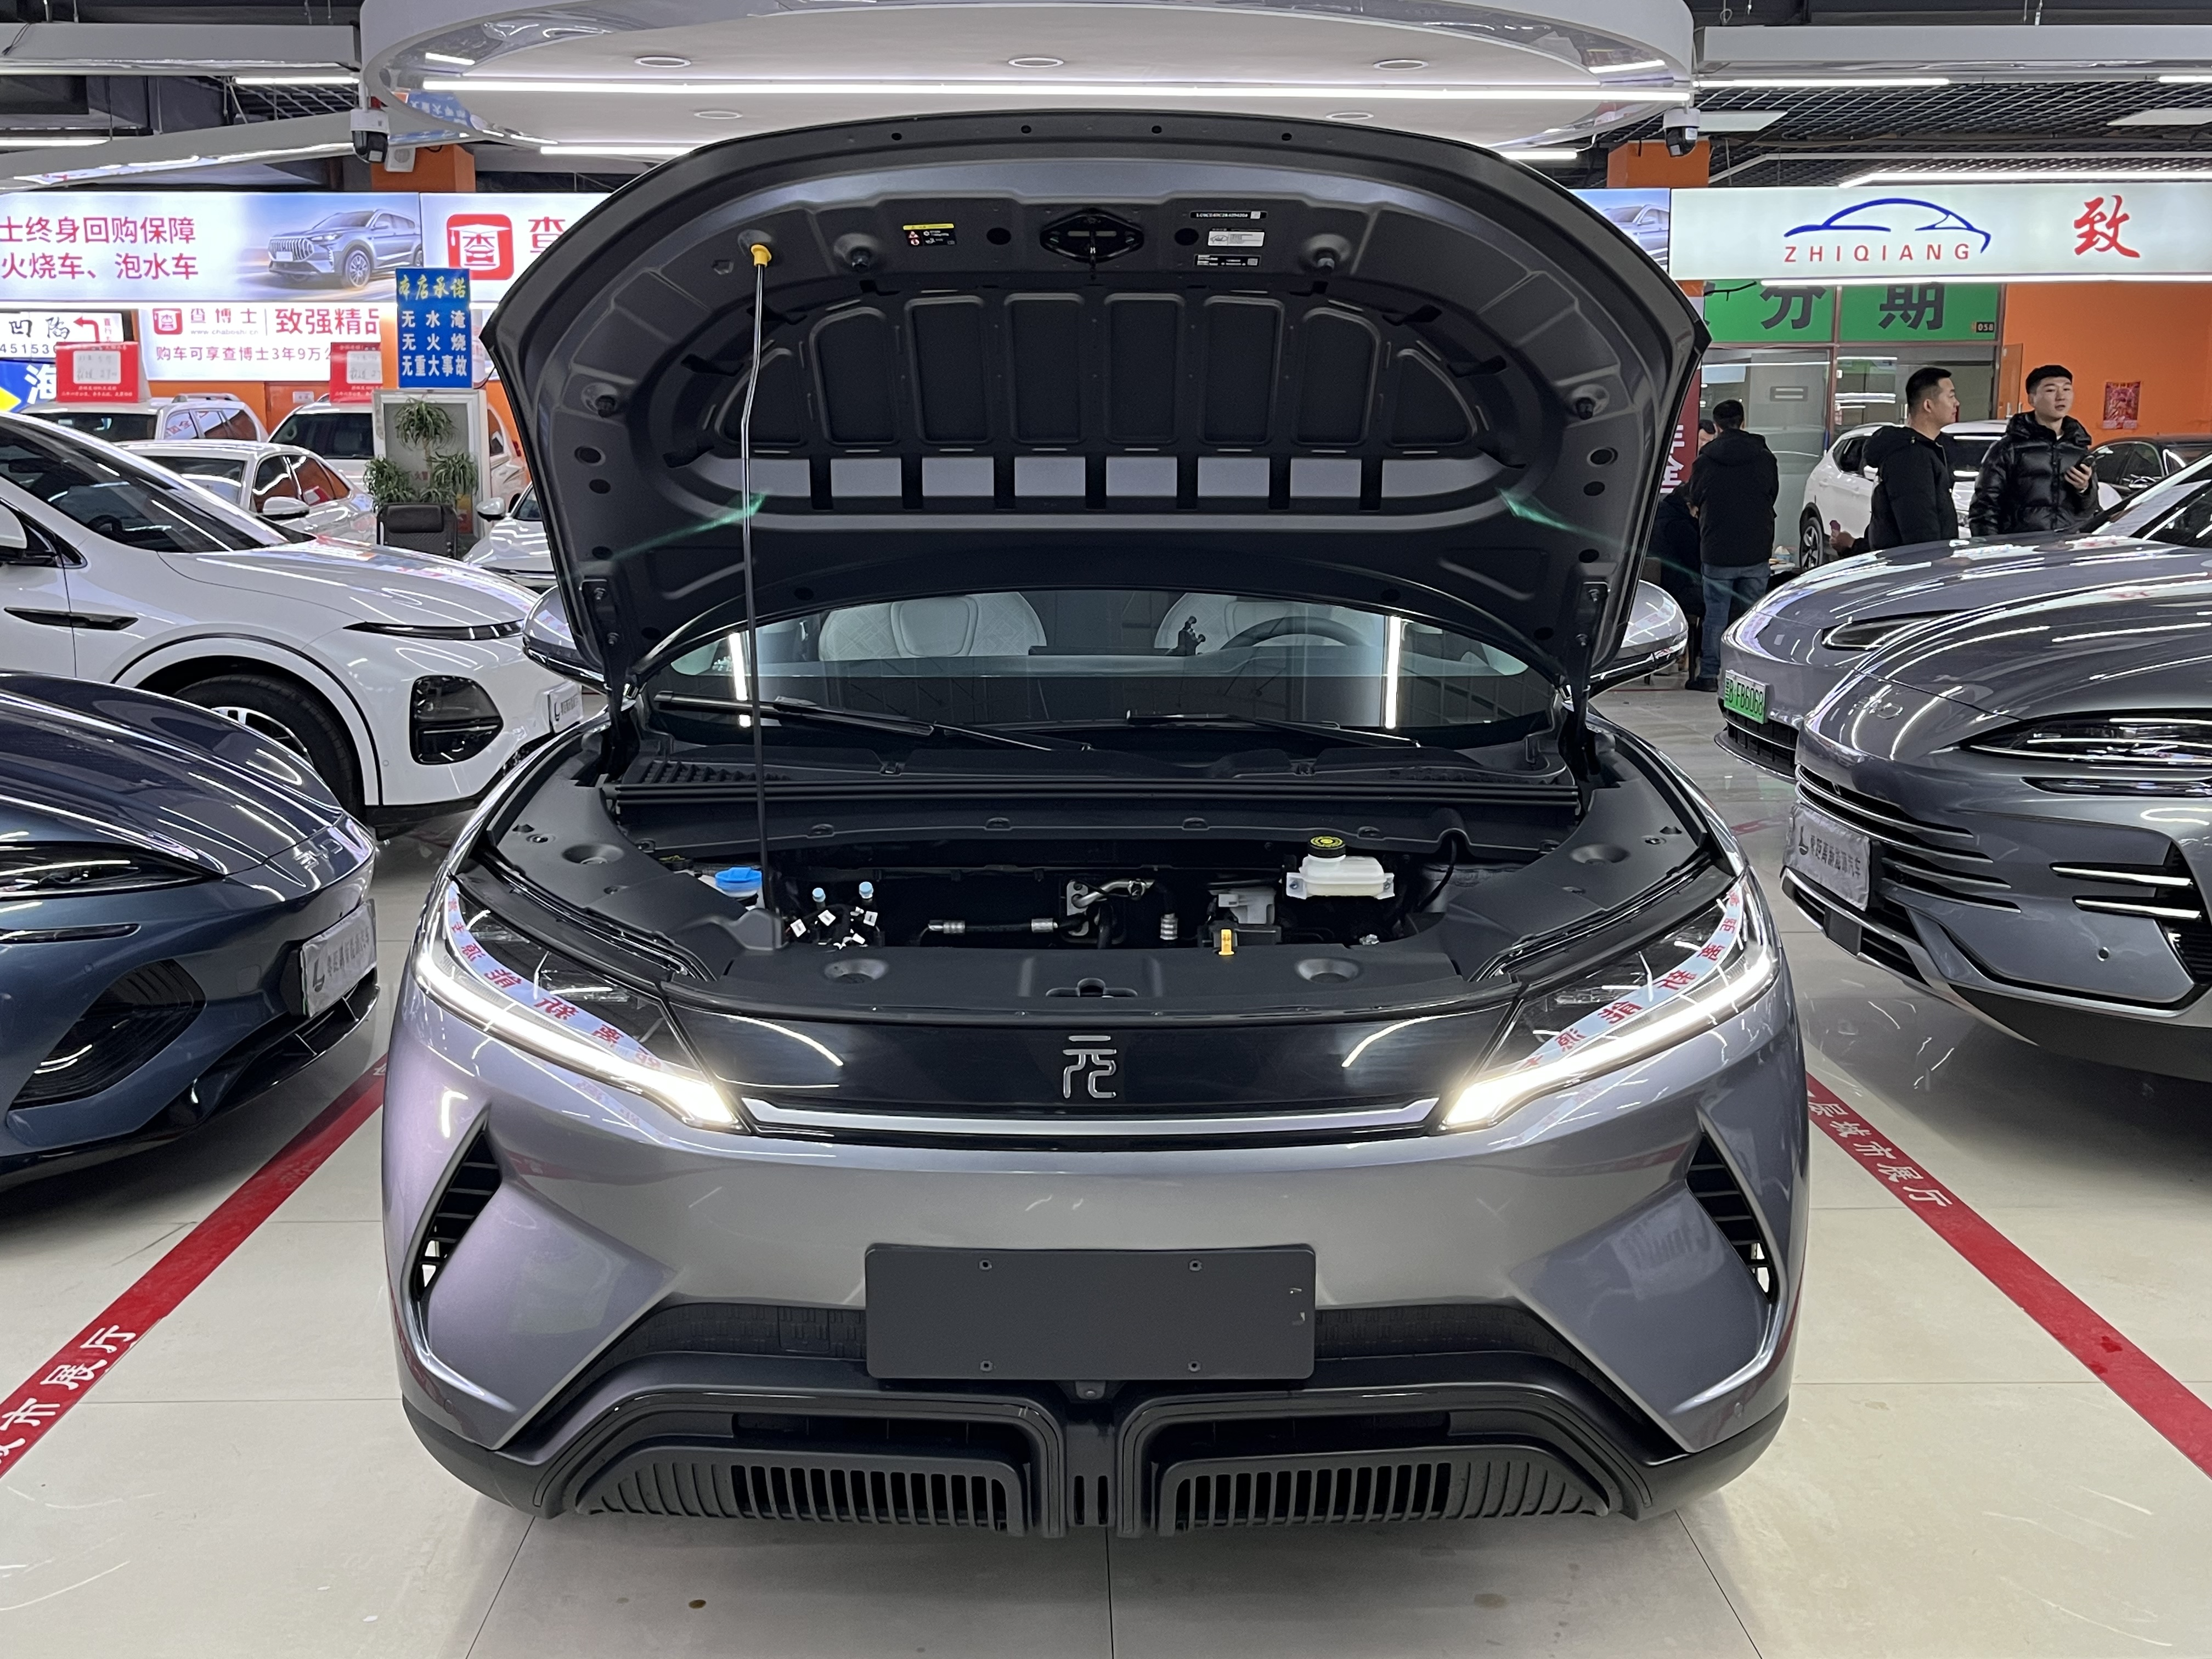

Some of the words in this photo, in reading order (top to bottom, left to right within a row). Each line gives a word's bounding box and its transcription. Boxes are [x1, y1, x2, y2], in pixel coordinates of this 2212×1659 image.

[0, 216, 196, 244] 士终身回购保障
[2074, 194, 2141, 258] 致
[2, 252, 199, 280] 火烧车、泡水车
[1784, 244, 1970, 262] ZHIQIANG
[275, 308, 380, 335] 致强精品
[0, 343, 57, 354] 45153
[402, 354, 467, 377] 无重大事故
